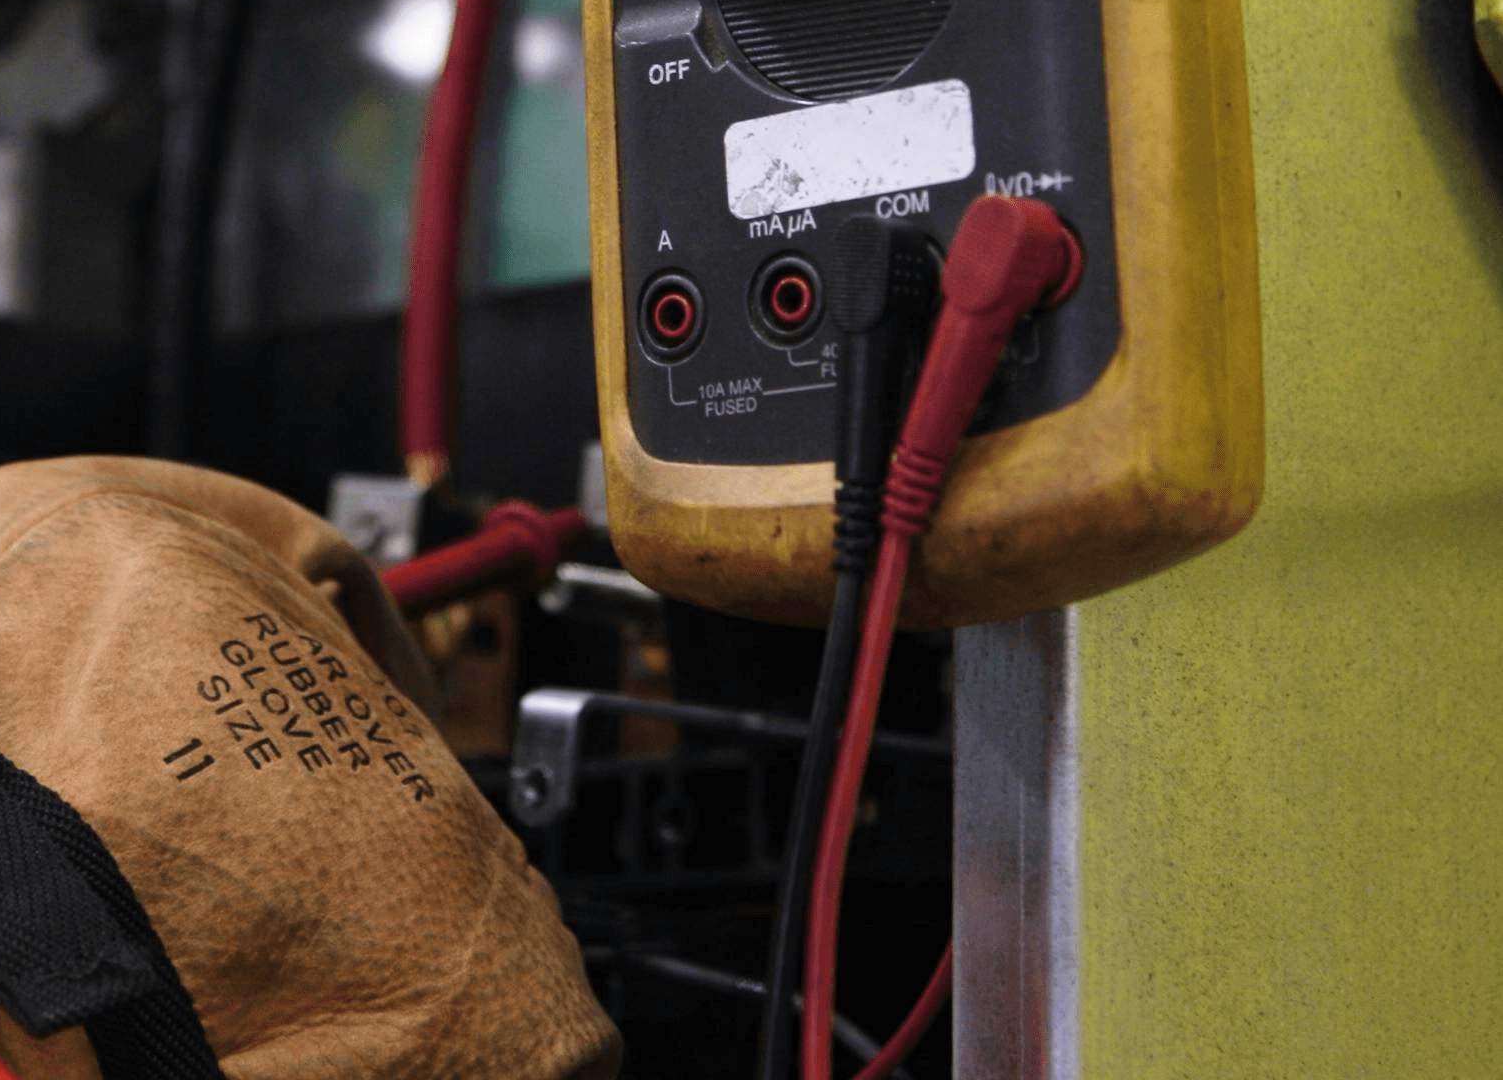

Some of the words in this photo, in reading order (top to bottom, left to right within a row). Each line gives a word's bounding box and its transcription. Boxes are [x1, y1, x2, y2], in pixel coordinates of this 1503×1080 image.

[648, 58, 691, 85] OFF
[875, 190, 930, 219] COM
[749, 213, 784, 239] mA
[657, 230, 674, 252] A
[699, 382, 726, 399] 10A
[728, 377, 763, 395] MAX
[704, 397, 758, 417] FUSED
[219, 638, 333, 773] GLOVE
[242, 612, 371, 771] RUBBER
[197, 674, 283, 771] SIZE
[162, 737, 215, 782] 11
[345, 692, 435, 803] OVER
